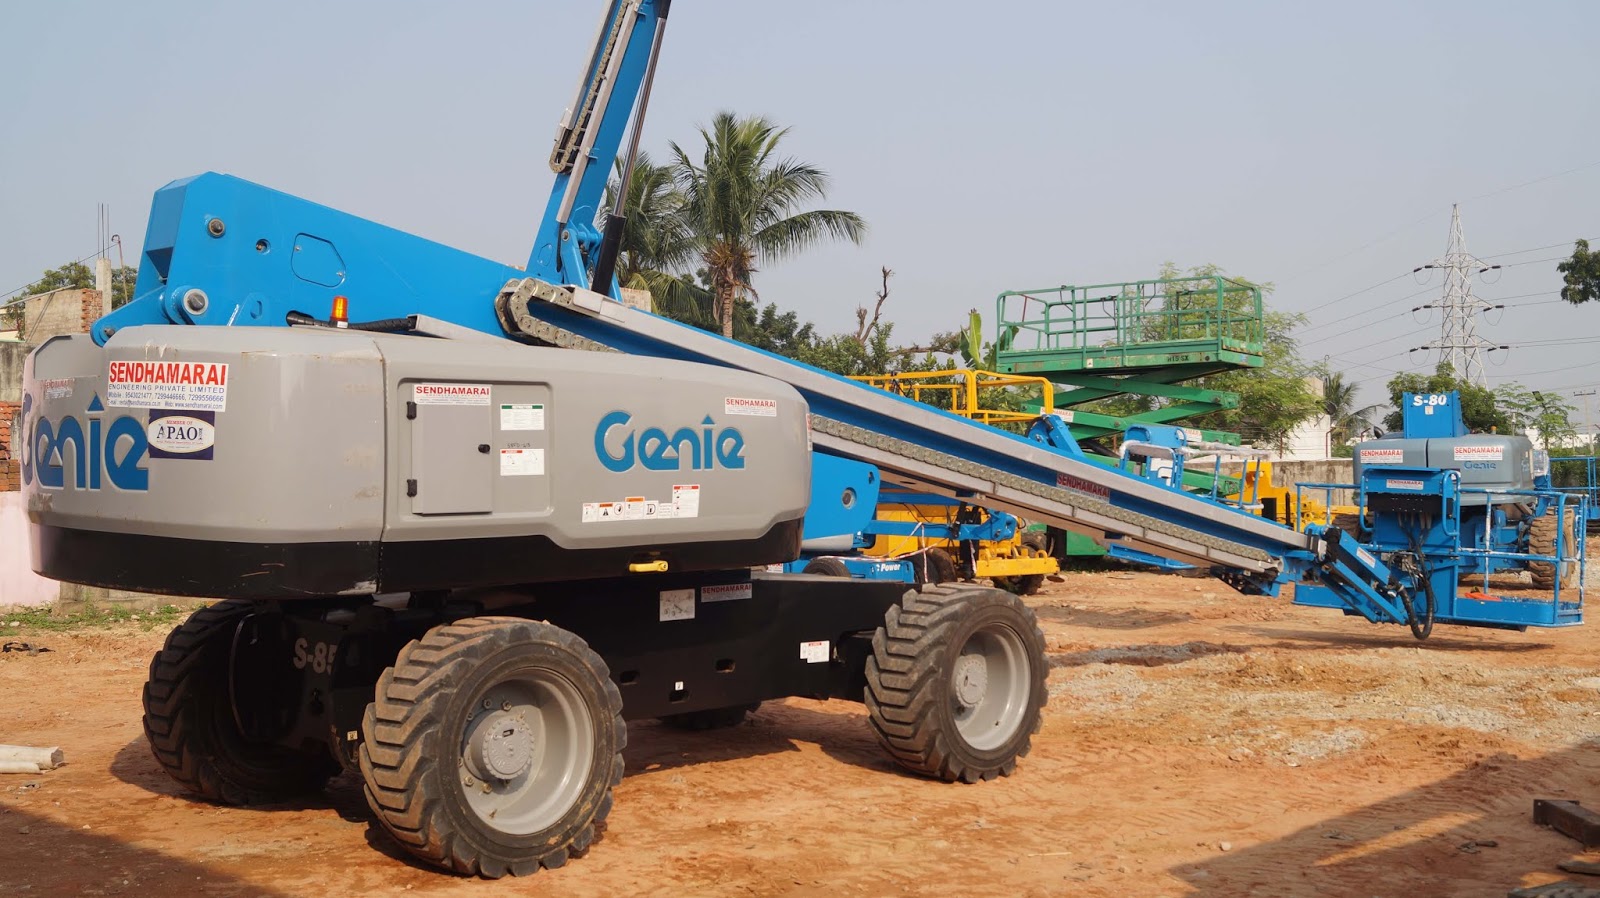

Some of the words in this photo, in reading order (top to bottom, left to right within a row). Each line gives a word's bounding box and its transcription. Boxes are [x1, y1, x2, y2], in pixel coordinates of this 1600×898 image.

[109, 362, 227, 386] SENDHAMARAI
[108, 383, 152, 391] ENGINEERING
[155, 384, 186, 393] PRIVATE
[189, 386, 225, 394] LIMITED
[416, 386, 490, 395] SENDHAMARAI
[725, 398, 776, 408] SENDHAMARAI
[1412, 394, 1447, 407] S-80
[594, 410, 746, 473] Genie
[1464, 460, 1497, 470] Genie
[880, 563, 901, 572] Power
[702, 583, 752, 594] SENDHAMARAI
